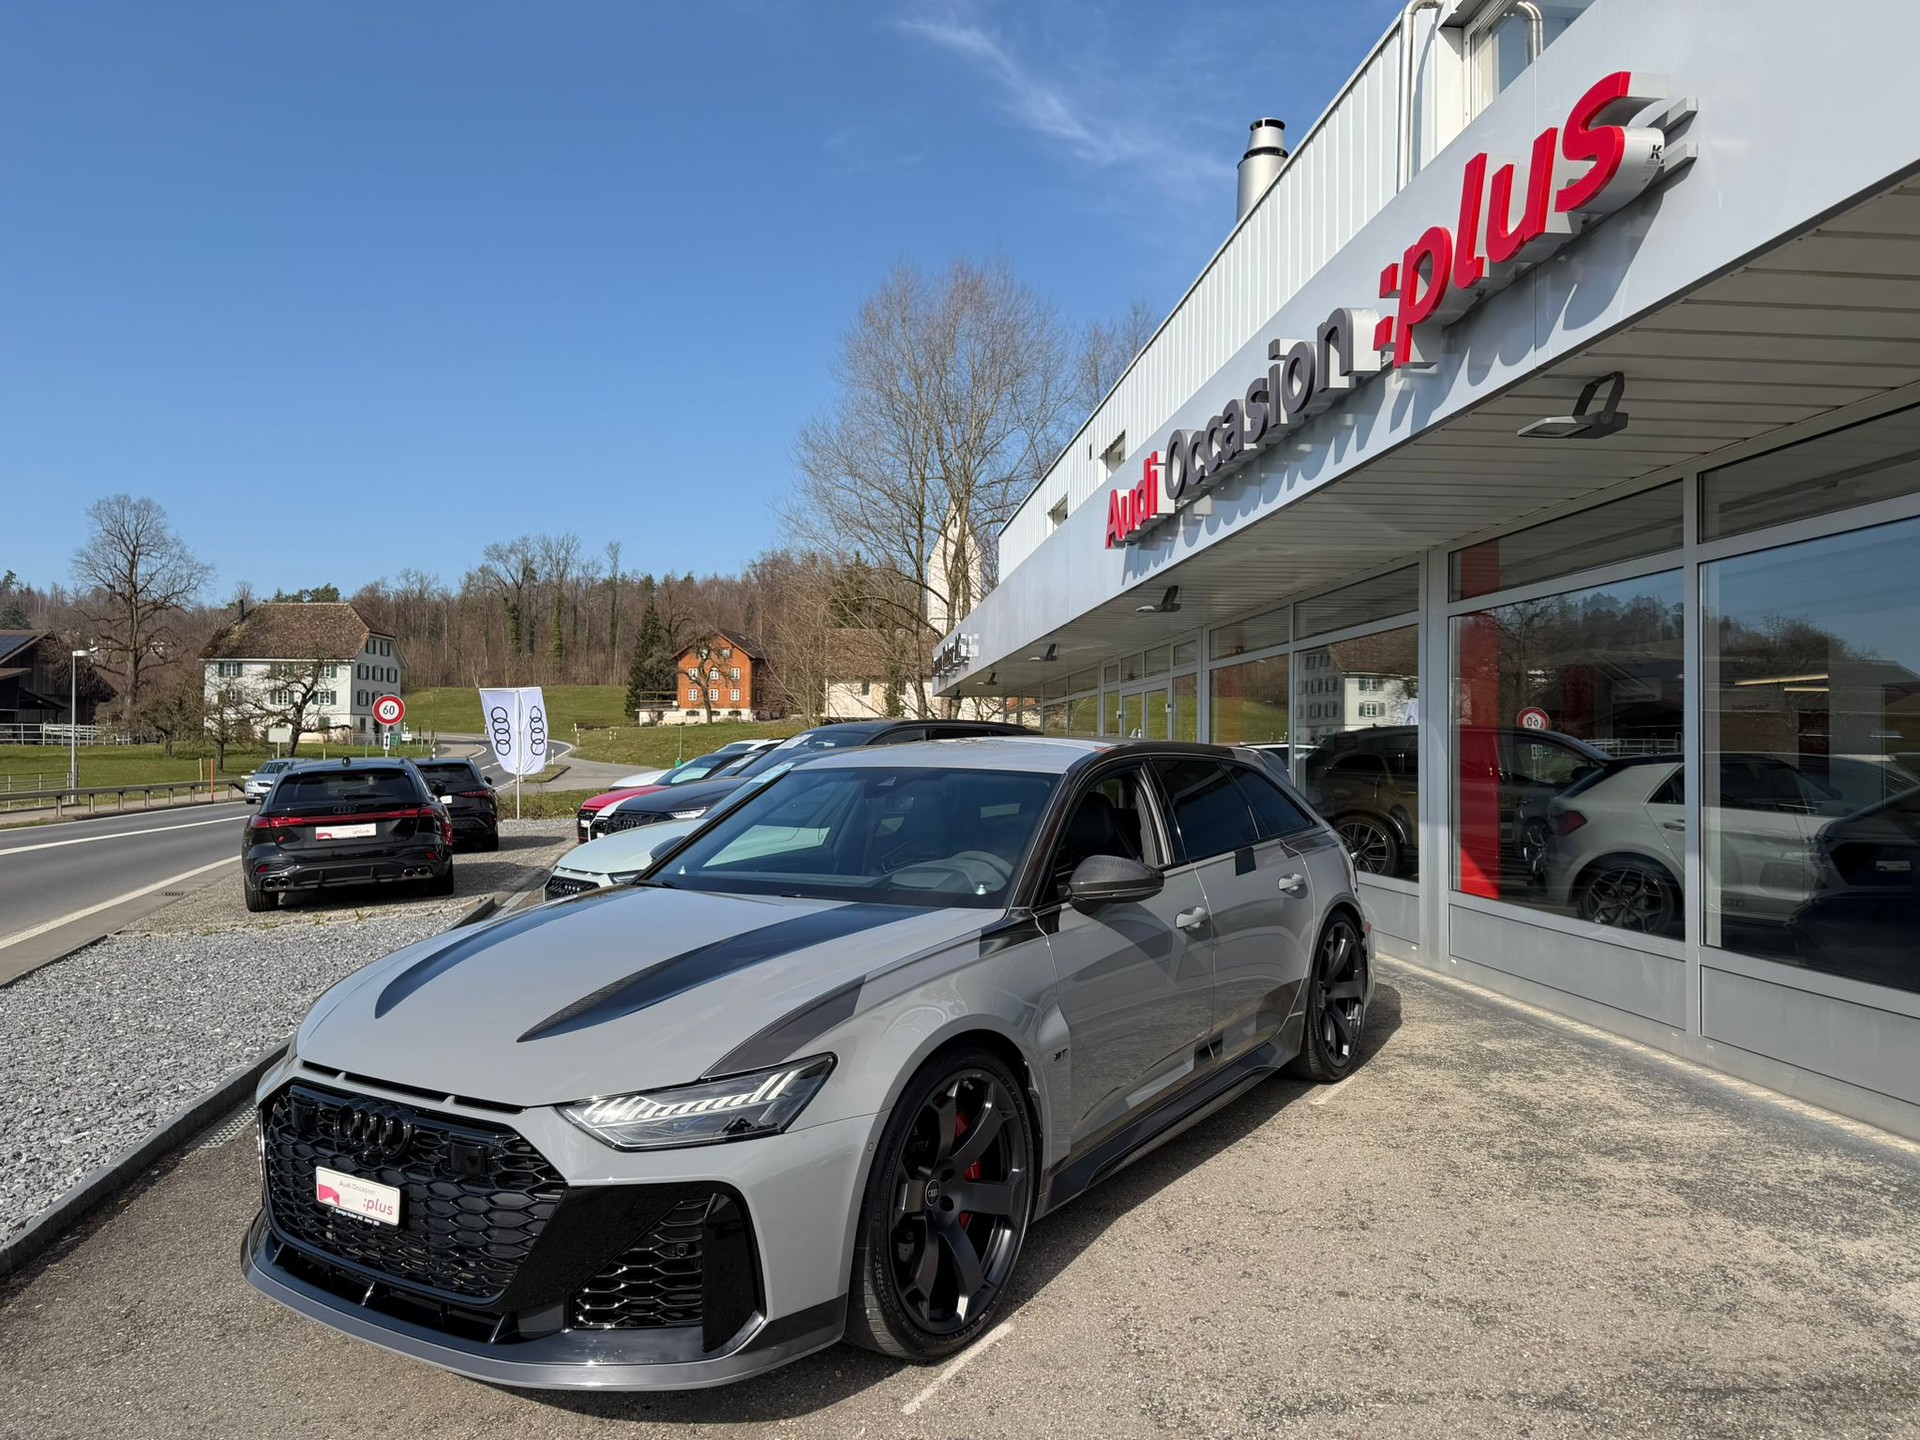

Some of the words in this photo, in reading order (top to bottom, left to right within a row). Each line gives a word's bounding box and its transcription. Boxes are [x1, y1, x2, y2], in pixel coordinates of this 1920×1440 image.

[1105, 451, 1158, 550] Audi
[1165, 307, 1353, 501] Occasion
[1373, 71, 1631, 369] :plus
[382, 705, 395, 715] 60
[339, 1180, 351, 1188] Audi
[352, 1183, 376, 1195] Occasion
[363, 1198, 394, 1216] :plus
